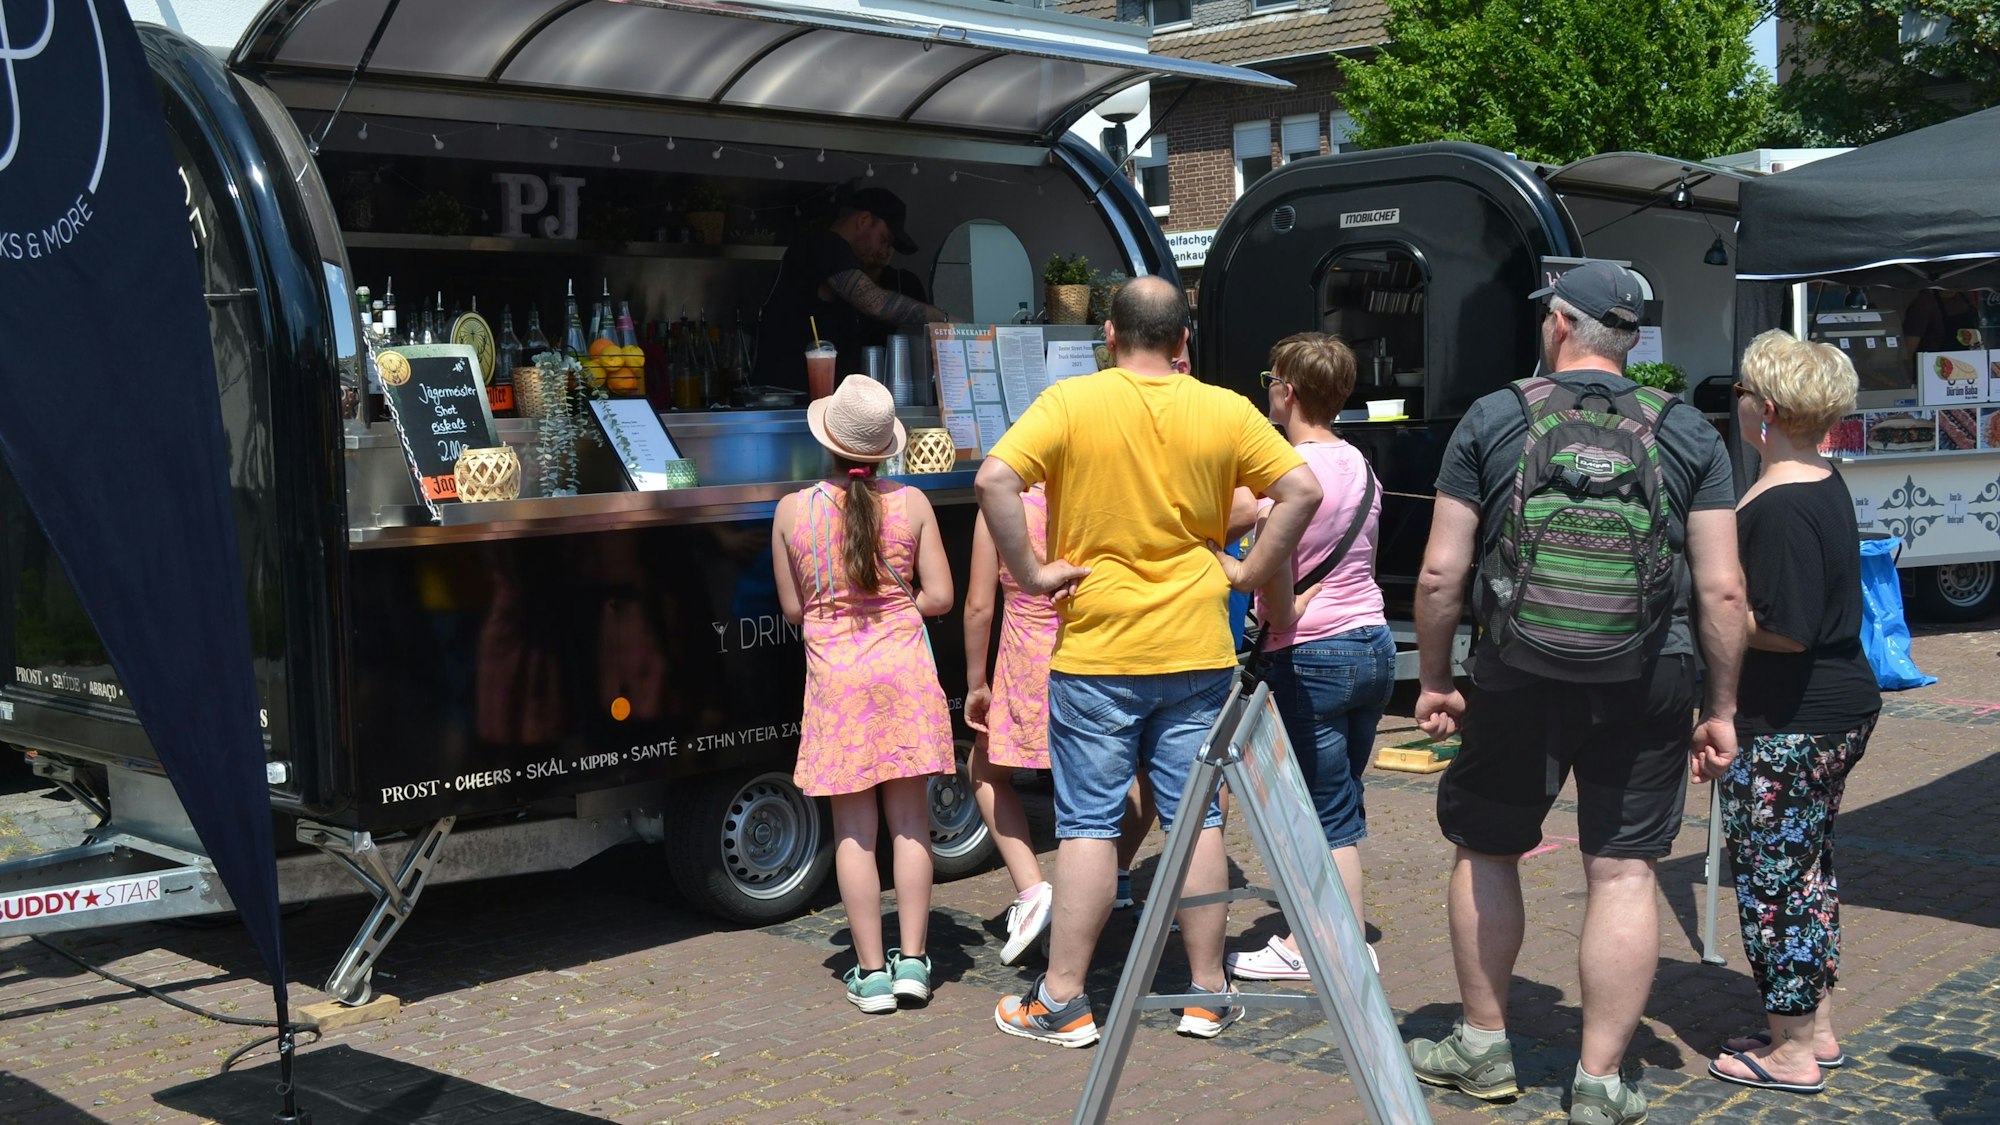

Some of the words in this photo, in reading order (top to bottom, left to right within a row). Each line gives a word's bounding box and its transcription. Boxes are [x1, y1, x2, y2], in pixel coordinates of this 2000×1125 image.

[491, 172, 586, 240] PJ
[1345, 210, 1397, 224] MOBILCHEF
[26, 232, 42, 259] &
[42, 194, 94, 254] MORE
[1167, 234, 1213, 246] elfachge
[418, 382, 478, 406] Jägermeister
[1965, 385, 1978, 395] Baba
[434, 404, 458, 417] Shot
[431, 418, 467, 433] eiskalt
[431, 475, 456, 494] Jäg
[740, 614, 804, 649] DRIN
[15, 666, 42, 686] PROST
[52, 672, 80, 692] SAÚDE
[89, 681, 117, 701] ABRAÇO
[697, 731, 735, 751] ΣΤΗΝ
[781, 721, 802, 738] ΣΑ
[381, 779, 440, 804] PROST
[455, 768, 512, 791] CHEERS
[526, 758, 568, 780] SKÅL
[580, 751, 619, 771] KIPPIS
[630, 737, 678, 762] SANTÉ
[104, 879, 159, 906] STAR
